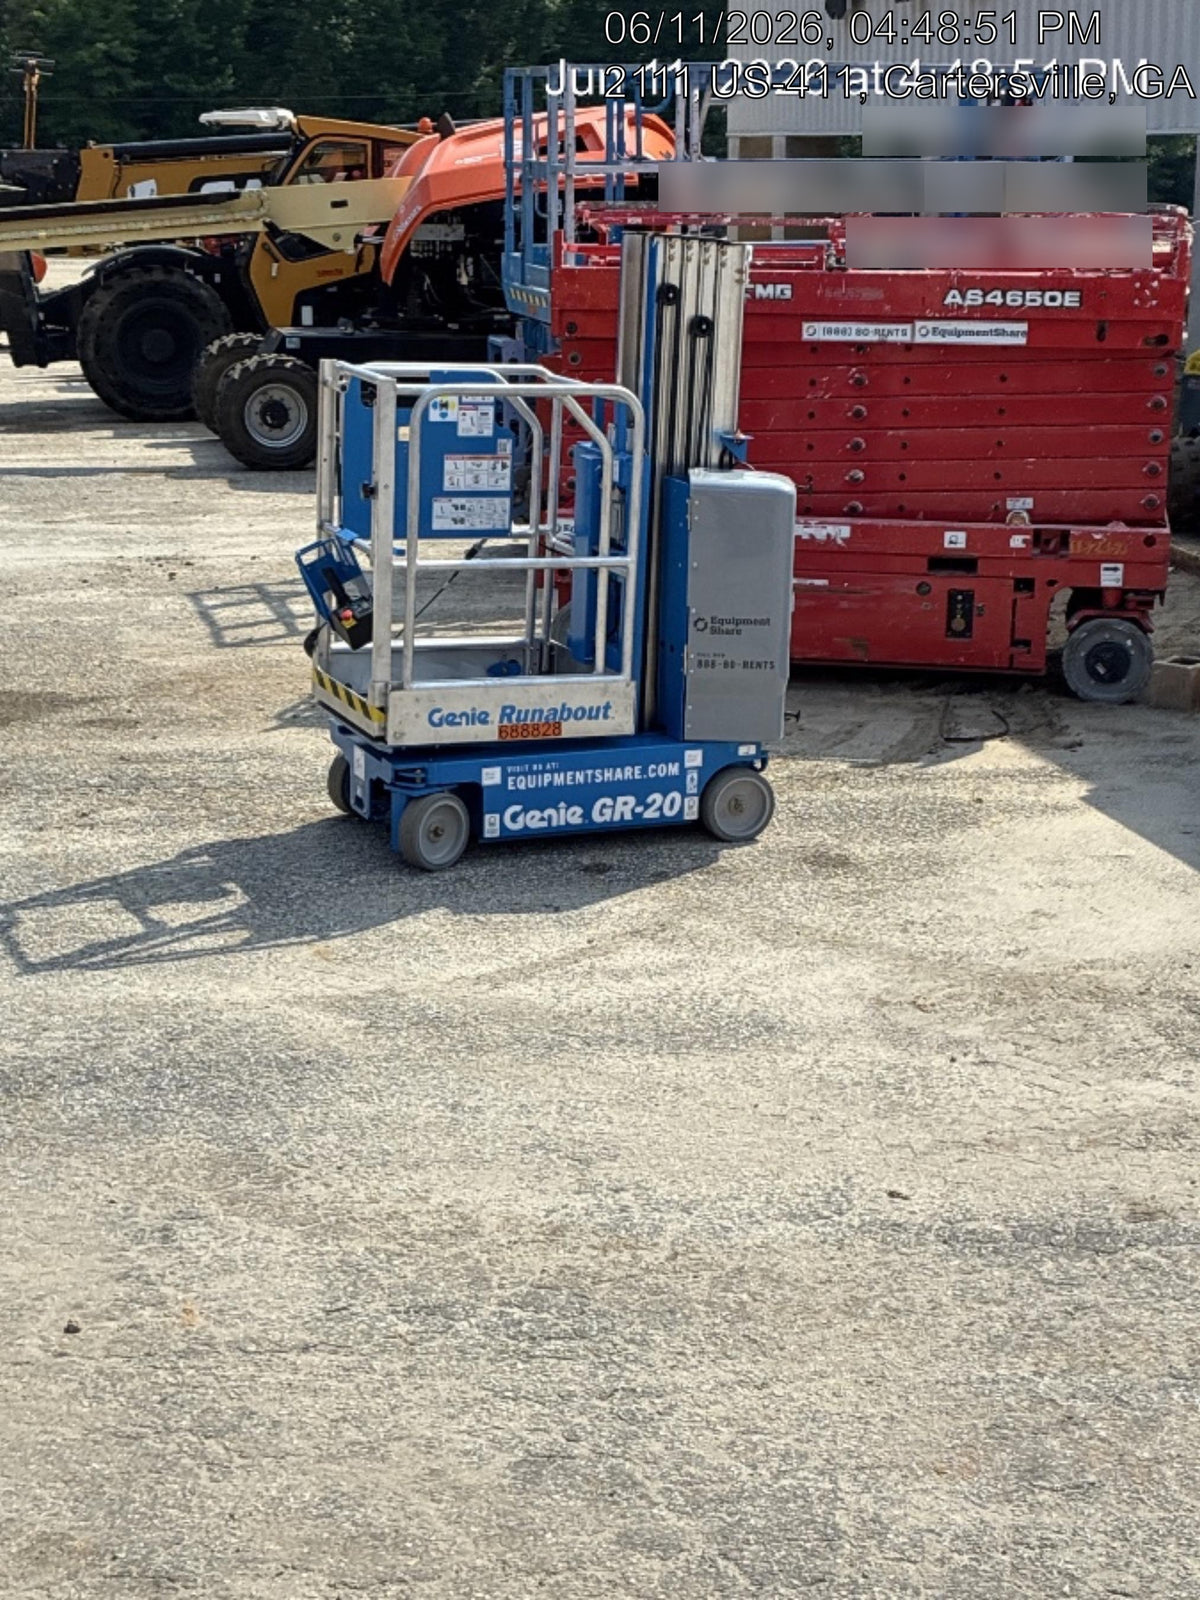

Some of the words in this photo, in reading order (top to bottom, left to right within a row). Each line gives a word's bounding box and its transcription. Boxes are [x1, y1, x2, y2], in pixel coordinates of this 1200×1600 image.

[943, 289, 1081, 307] AS4650E
[931, 326, 1027, 338] EquipmentShare
[710, 616, 771, 628] Equipment
[710, 626, 742, 635] Share
[428, 707, 490, 728] Genie
[499, 700, 612, 724] Runabout
[499, 721, 562, 740] 688828
[507, 762, 680, 791] EQUIPMENTSHARE.COM
[503, 801, 584, 831] Genie
[591, 791, 682, 823] GR-20
